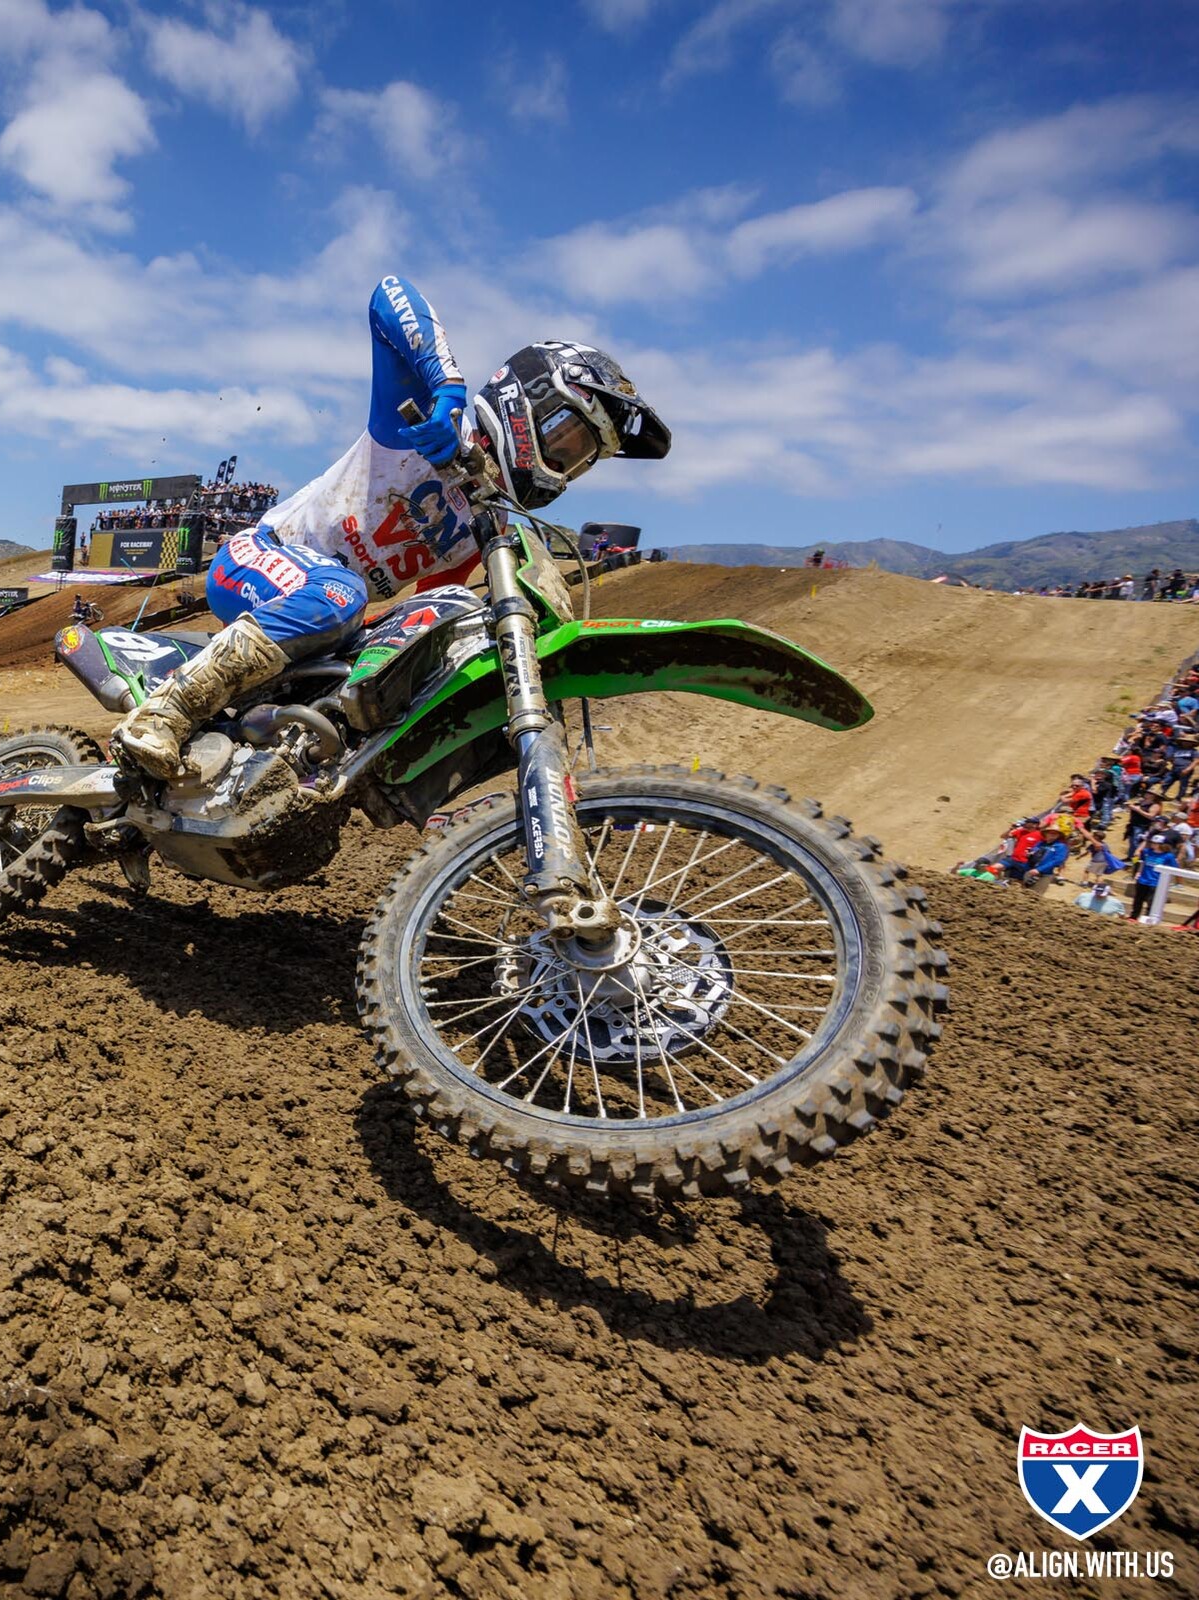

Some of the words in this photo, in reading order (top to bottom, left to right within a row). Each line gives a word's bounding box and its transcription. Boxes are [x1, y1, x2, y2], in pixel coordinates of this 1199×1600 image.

[381, 275, 424, 351] CANVAS
[109, 483, 143, 494] MONSTER
[342, 515, 396, 600] SportClips
[531, 816, 544, 859] ACERBIS
